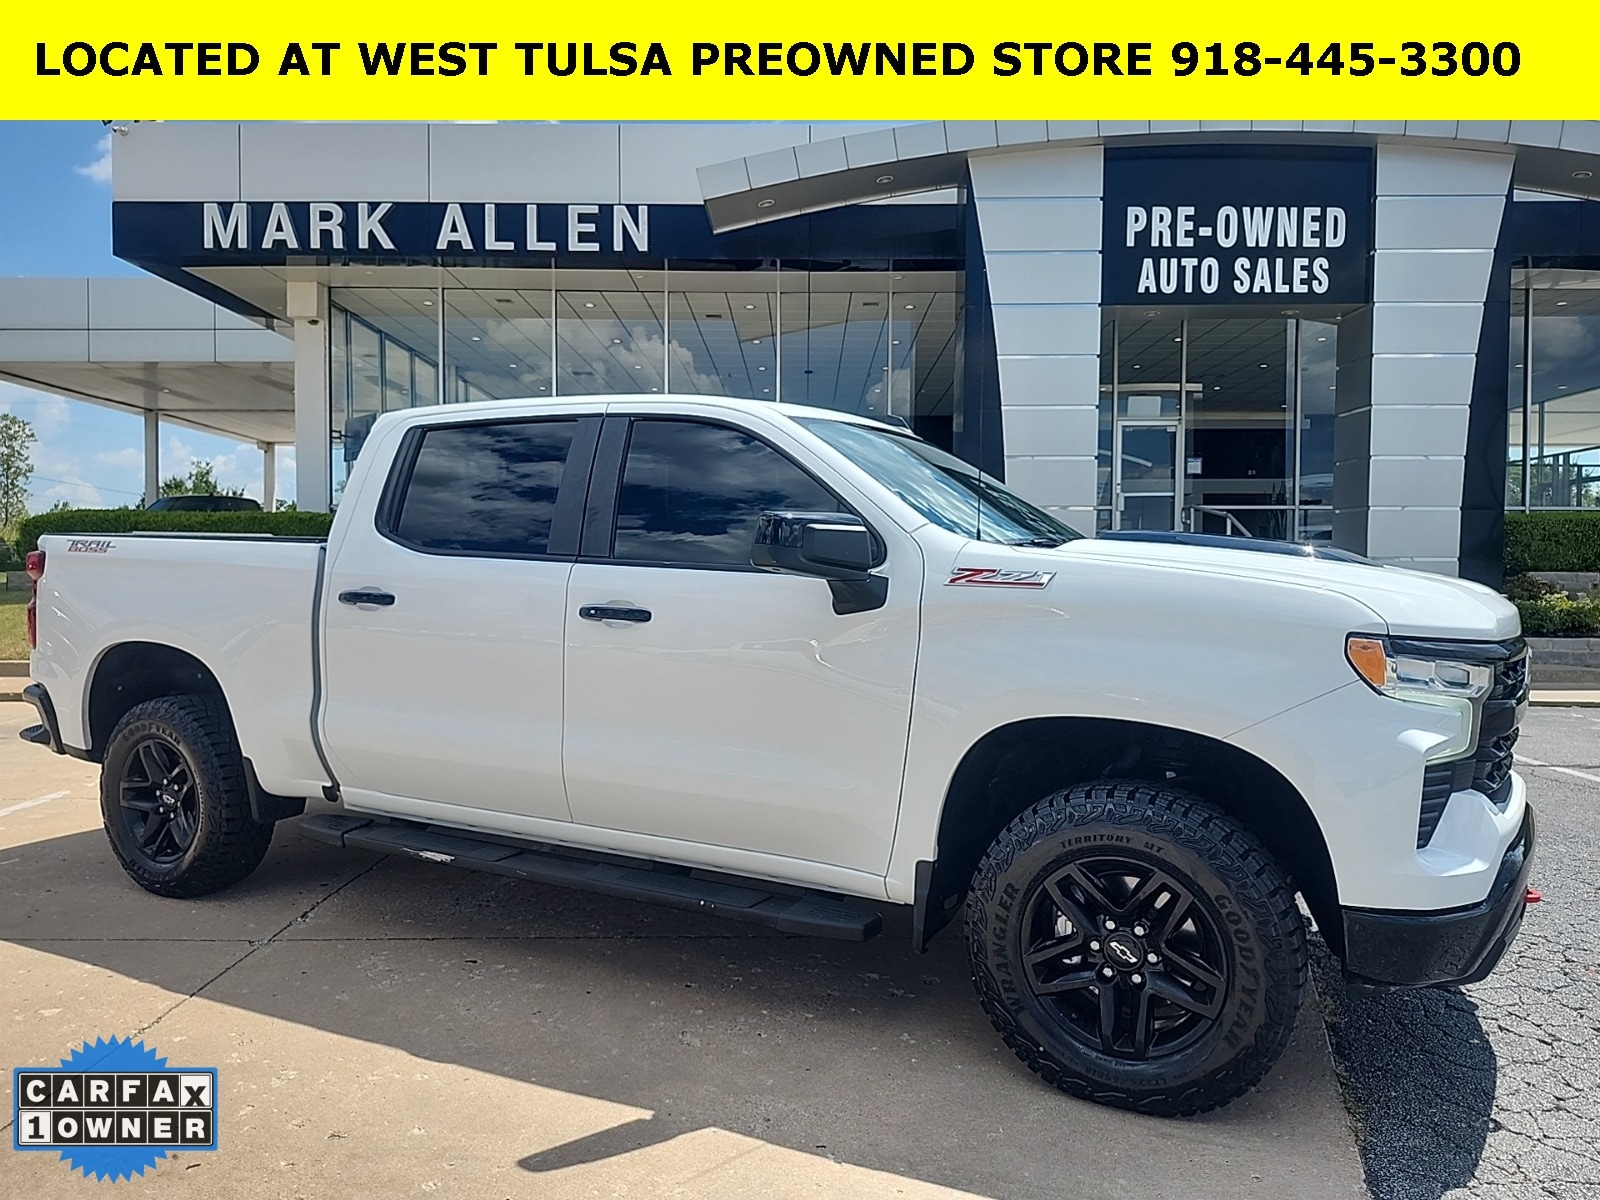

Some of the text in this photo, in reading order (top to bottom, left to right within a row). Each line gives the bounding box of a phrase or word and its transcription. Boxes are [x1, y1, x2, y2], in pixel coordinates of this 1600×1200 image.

[203, 202, 649, 253] MARK ALLEN
[1126, 205, 1347, 249] PRE-OWNED
[1137, 257, 1329, 294] AUTO SALES
[67, 539, 116, 548] TRAIL
[944, 567, 1057, 589] Z71
[122, 721, 182, 747] GOODYEAR
[1059, 833, 1133, 849] TERRITORY
[992, 881, 1024, 1015] WRANGLER
[1214, 894, 1261, 1048] GOODYEAR
